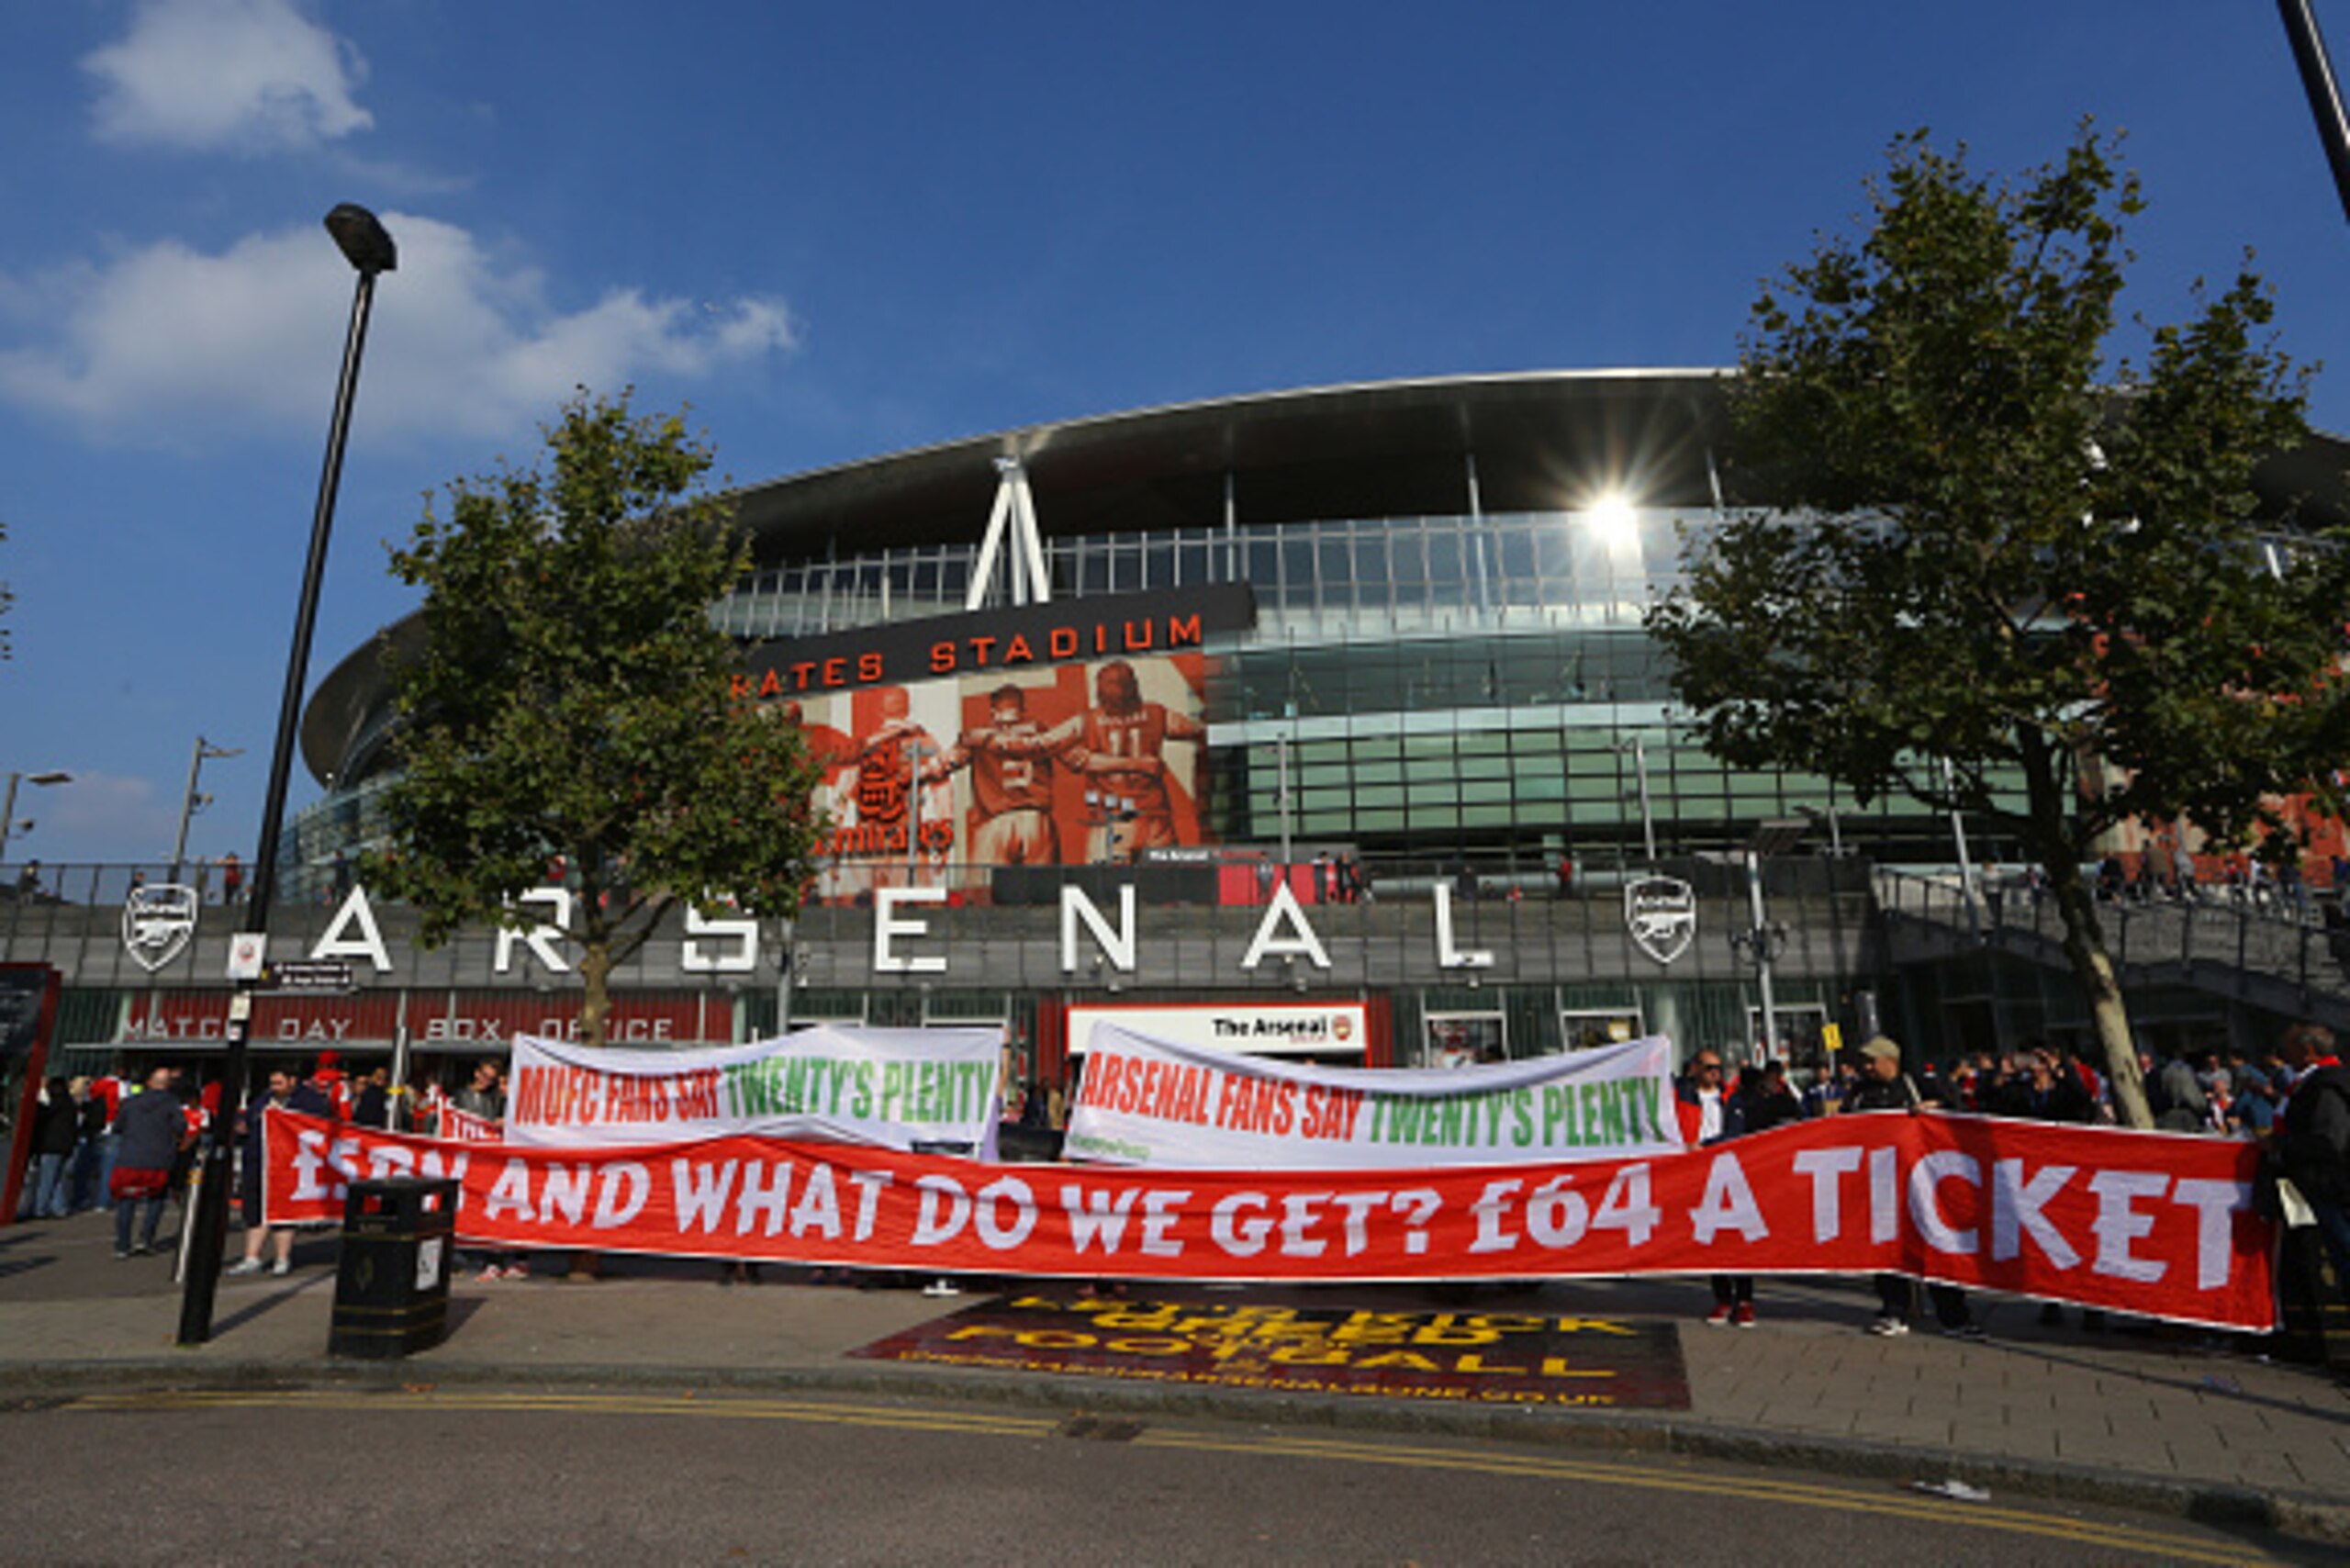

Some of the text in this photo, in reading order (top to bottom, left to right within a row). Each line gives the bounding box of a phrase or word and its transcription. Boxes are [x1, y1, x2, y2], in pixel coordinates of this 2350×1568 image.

[929, 612, 1203, 674] STADIUM
[309, 881, 1495, 975] ARSENAL
[278, 1017, 352, 1041] DAY
[425, 1017, 502, 1041] BOX
[540, 1017, 673, 1041] OFICE
[1211, 1015, 1328, 1036] The Arsenal
[513, 1065, 599, 1127] MUFC
[603, 1072, 670, 1124] FANS
[722, 1055, 875, 1120] TWENTY'S
[883, 1059, 995, 1125] PLENTY
[1080, 1050, 1667, 1148] ARSENAL FANS SAY TWENTY'S PLENTY
[484, 1157, 653, 1229] AND
[672, 1157, 894, 1243] WHAT
[909, 1173, 1040, 1251] DO
[1059, 1184, 1193, 1258] WE
[1210, 1188, 1444, 1258] GET?
[1469, 1162, 1662, 1256] £64
[1688, 1150, 1771, 1246] A
[1791, 1144, 2255, 1293] TICKET
